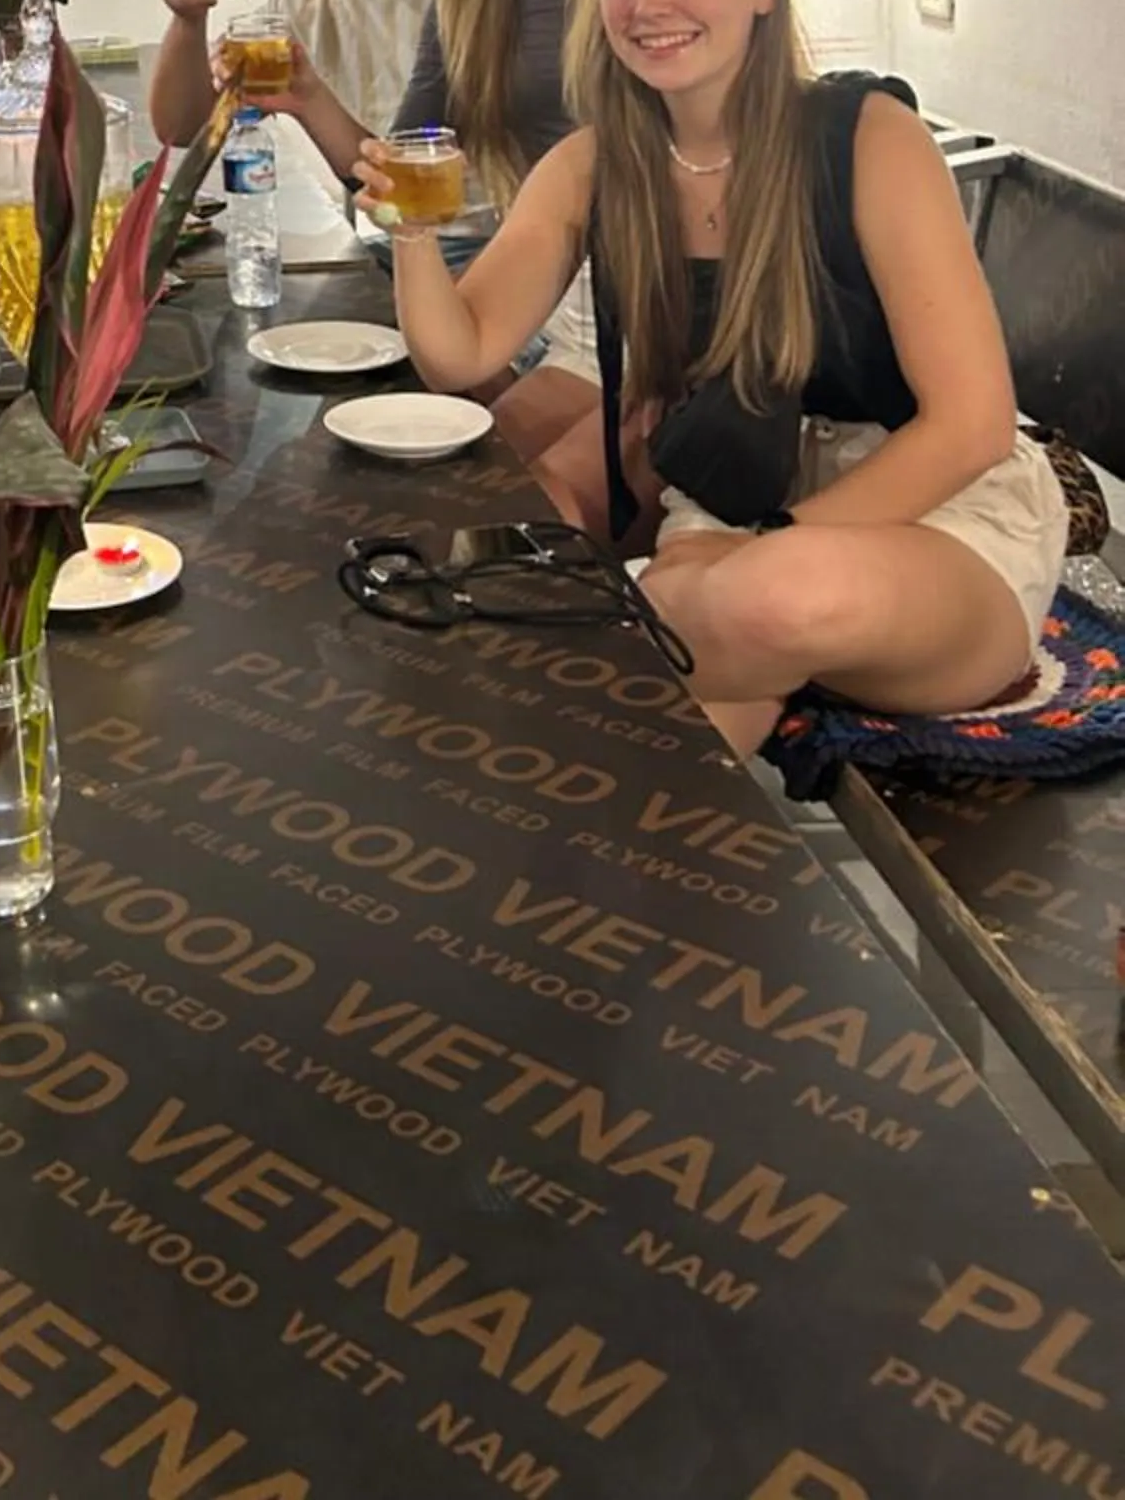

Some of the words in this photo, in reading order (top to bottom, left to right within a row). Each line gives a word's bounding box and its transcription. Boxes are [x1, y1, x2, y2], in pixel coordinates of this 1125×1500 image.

[210, 650, 616, 804] PLYWOOD
[325, 741, 413, 781] FILM
[424, 776, 551, 835] FACED
[566, 829, 779, 917] PLYWOOD
[65, 715, 475, 896] PLYWOOD
[491, 878, 974, 1108] VIETNAM
[173, 821, 262, 866] FILM
[271, 861, 399, 927] FACED
[416, 924, 634, 1027] PLYWOOD
[661, 1024, 774, 1084] VIET
[794, 1086, 924, 1152] NAM
[94, 960, 229, 1034] FACED
[239, 1034, 463, 1157] PLYWOOD
[487, 1156, 608, 1226] VIET
[623, 1229, 759, 1312] NAM
[128, 1098, 666, 1443] VIETNAM
[324, 980, 847, 1259] VIETNAM
[32, 1161, 260, 1309] PLYWOOD
[278, 1311, 405, 1397] VIET
[416, 1402, 560, 1499] NAM
